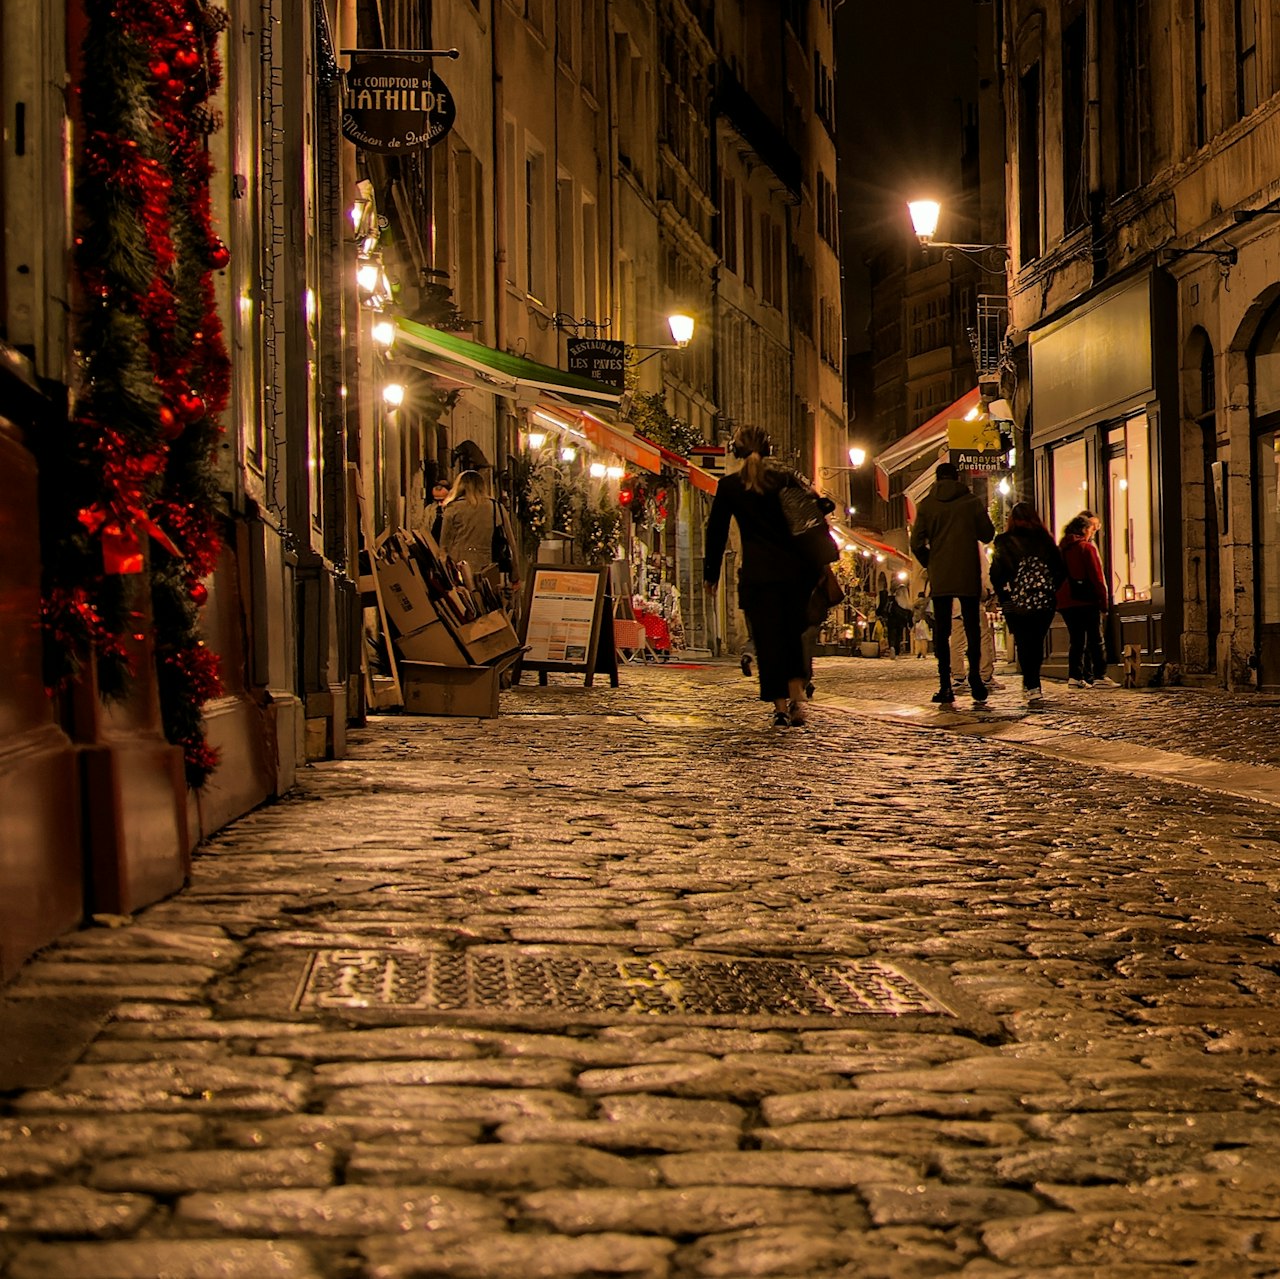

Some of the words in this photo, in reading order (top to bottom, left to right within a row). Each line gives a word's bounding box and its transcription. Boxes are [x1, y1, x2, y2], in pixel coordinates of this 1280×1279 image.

[353, 78, 362, 87] LE
[364, 76, 419, 89] COMPTOIR
[342, 113, 383, 147] Maison
[387, 137, 401, 148] de
[569, 341, 622, 357] RESTAURANT
[570, 358, 588, 369] LES
